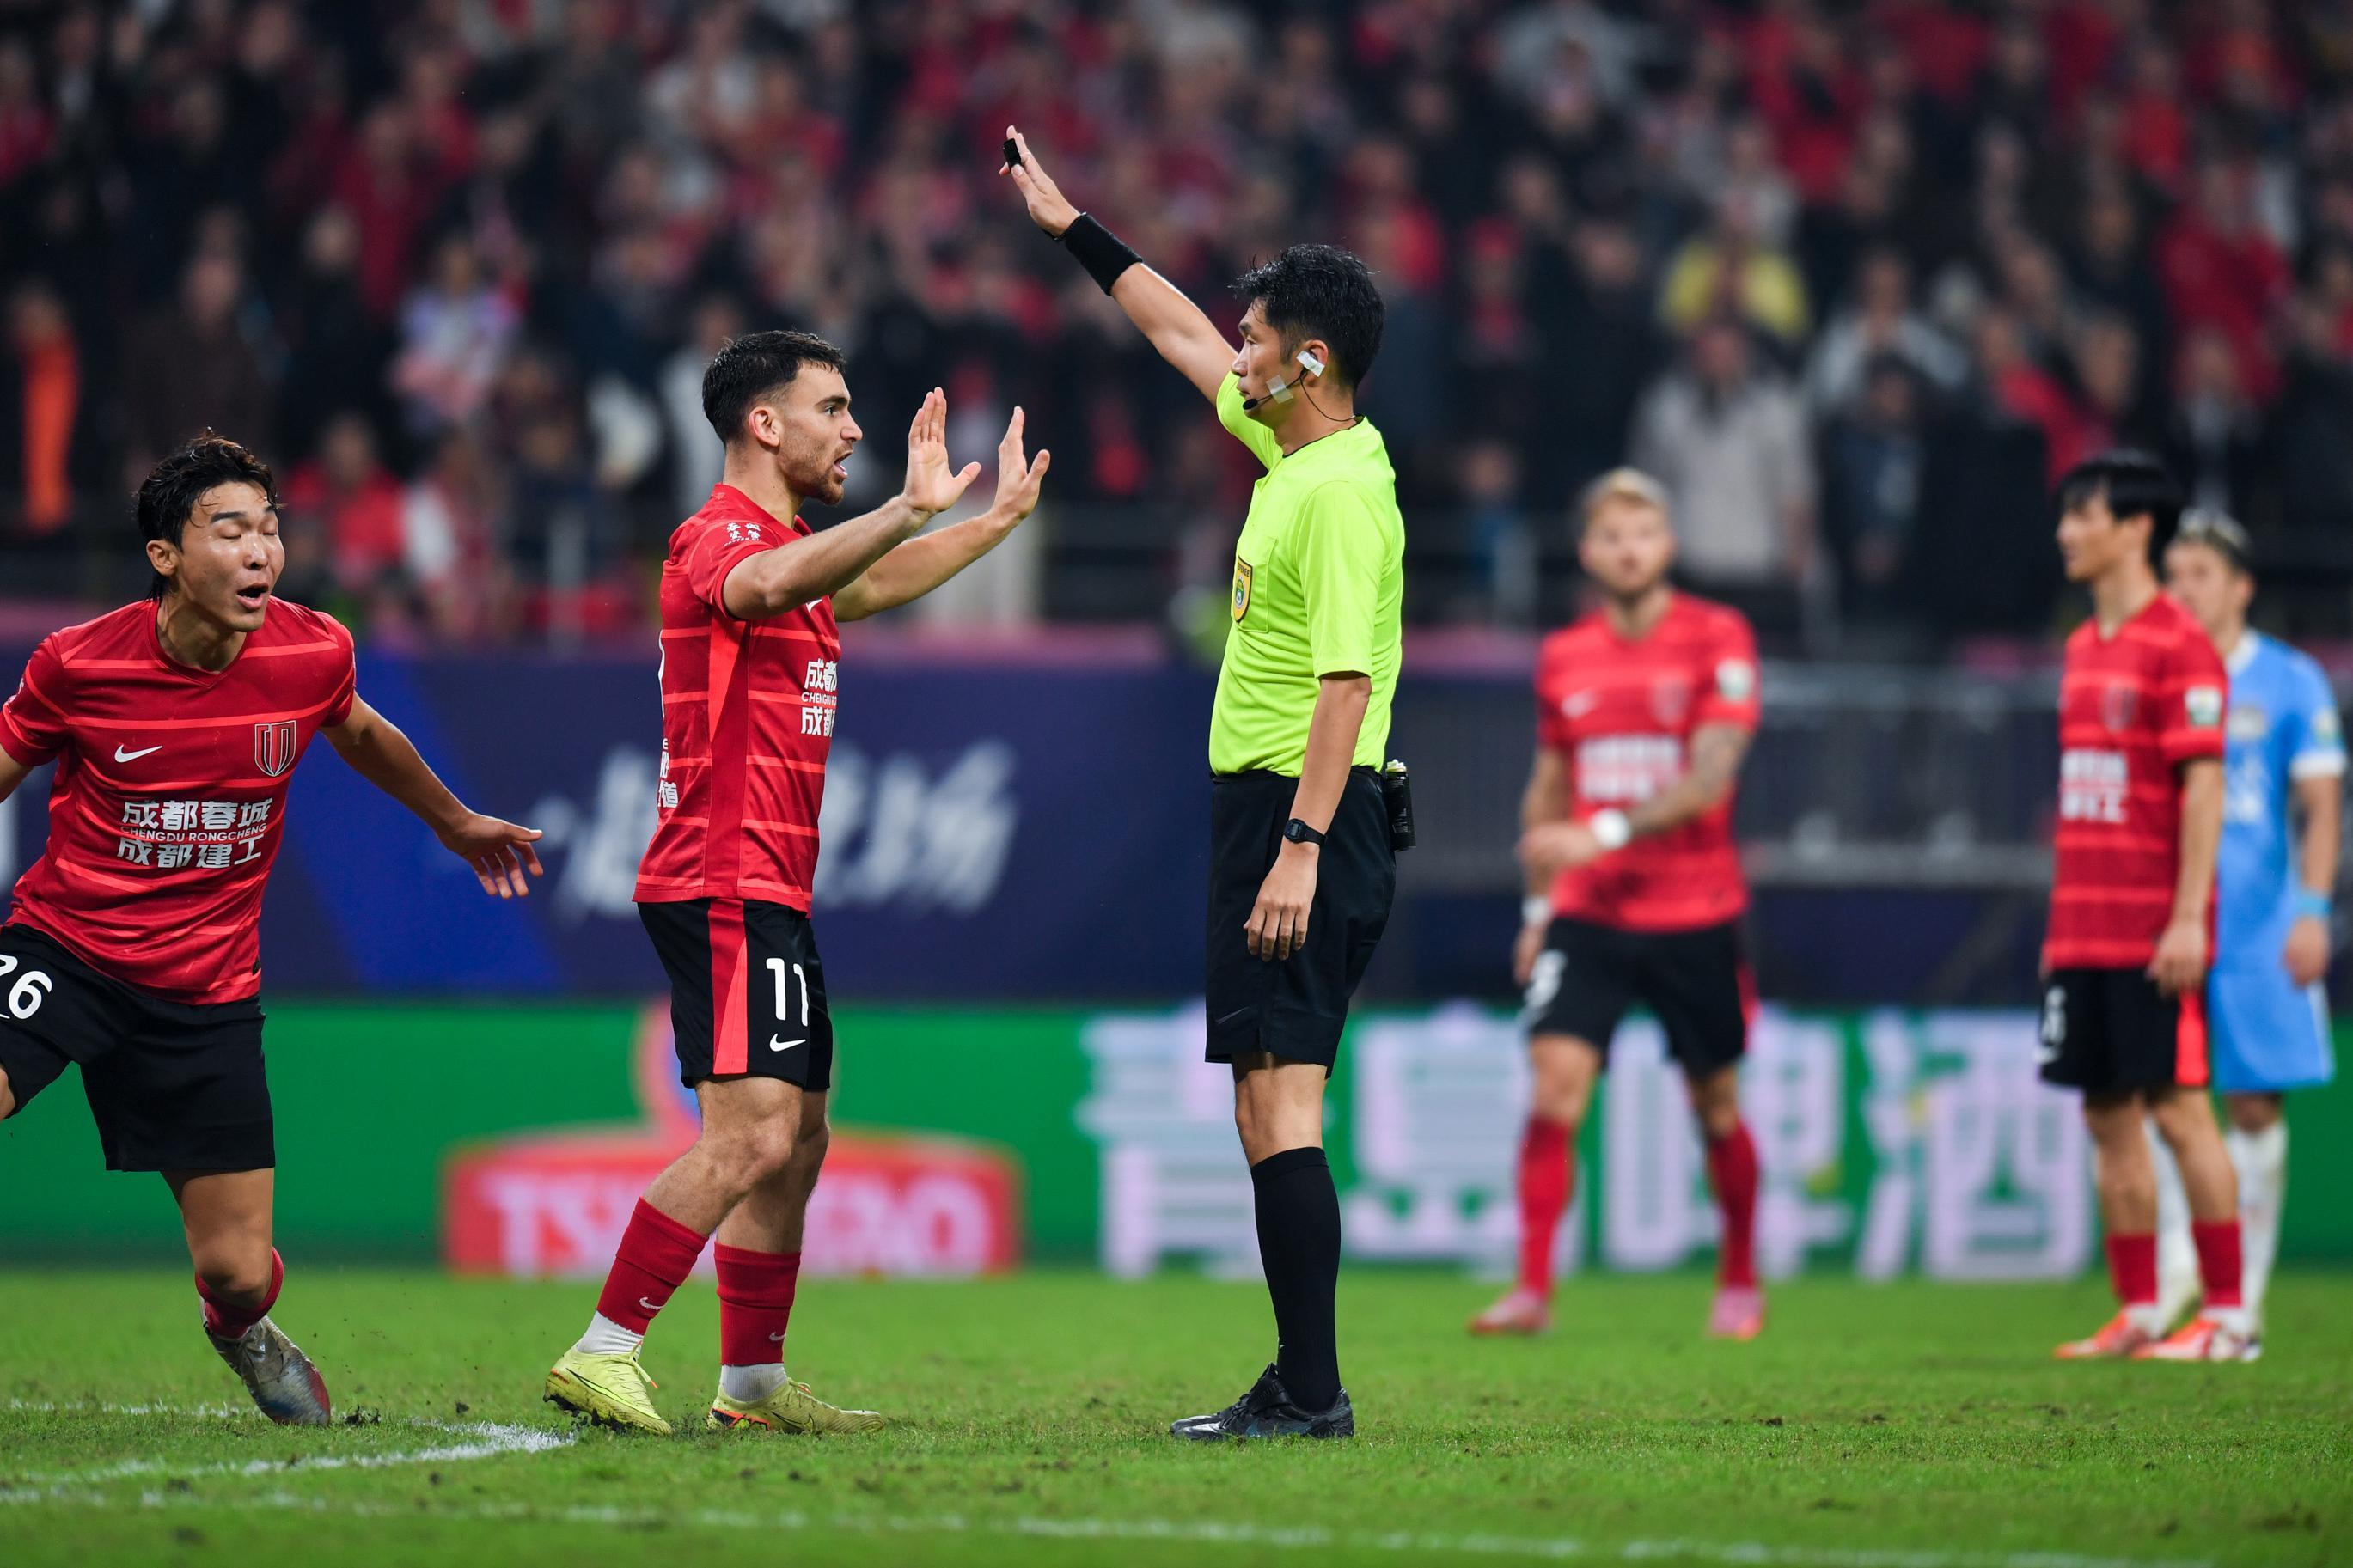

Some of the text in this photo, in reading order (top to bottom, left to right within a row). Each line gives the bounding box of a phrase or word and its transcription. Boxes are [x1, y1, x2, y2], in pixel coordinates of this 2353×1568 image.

[121, 796, 273, 831] 成都蓉城
[119, 821, 267, 843] CHENGDU RONGCHENG
[118, 833, 264, 868] 成都建工
[766, 957, 809, 1027] 11
